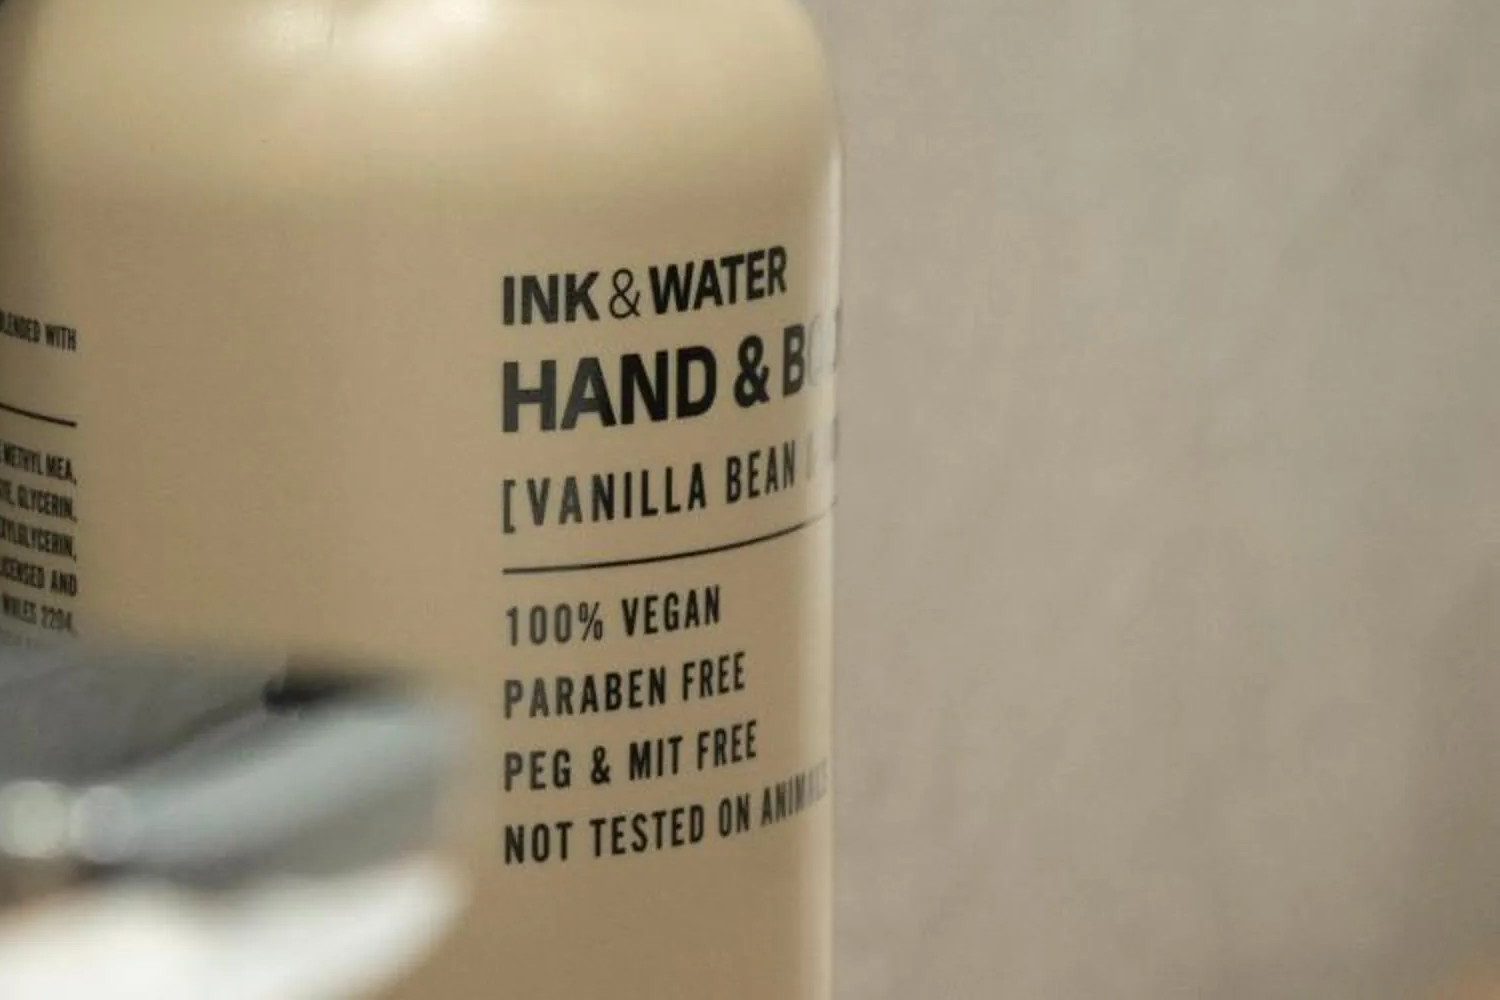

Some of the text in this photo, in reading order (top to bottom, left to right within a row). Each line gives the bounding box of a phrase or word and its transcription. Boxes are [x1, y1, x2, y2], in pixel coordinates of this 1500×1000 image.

[45, 323, 77, 351] WITH
[502, 344, 718, 432] HAND
[733, 334, 770, 408] &
[725, 440, 796, 504] BEAN
[50, 568, 78, 597] AND
[505, 584, 722, 646] 100% VEGAN
[504, 651, 746, 719] PARABEN FREE
[504, 719, 758, 792] PEG & MIT FREE
[505, 821, 574, 865] NOT
[589, 804, 704, 859] TESTED
[718, 792, 751, 838] ON
